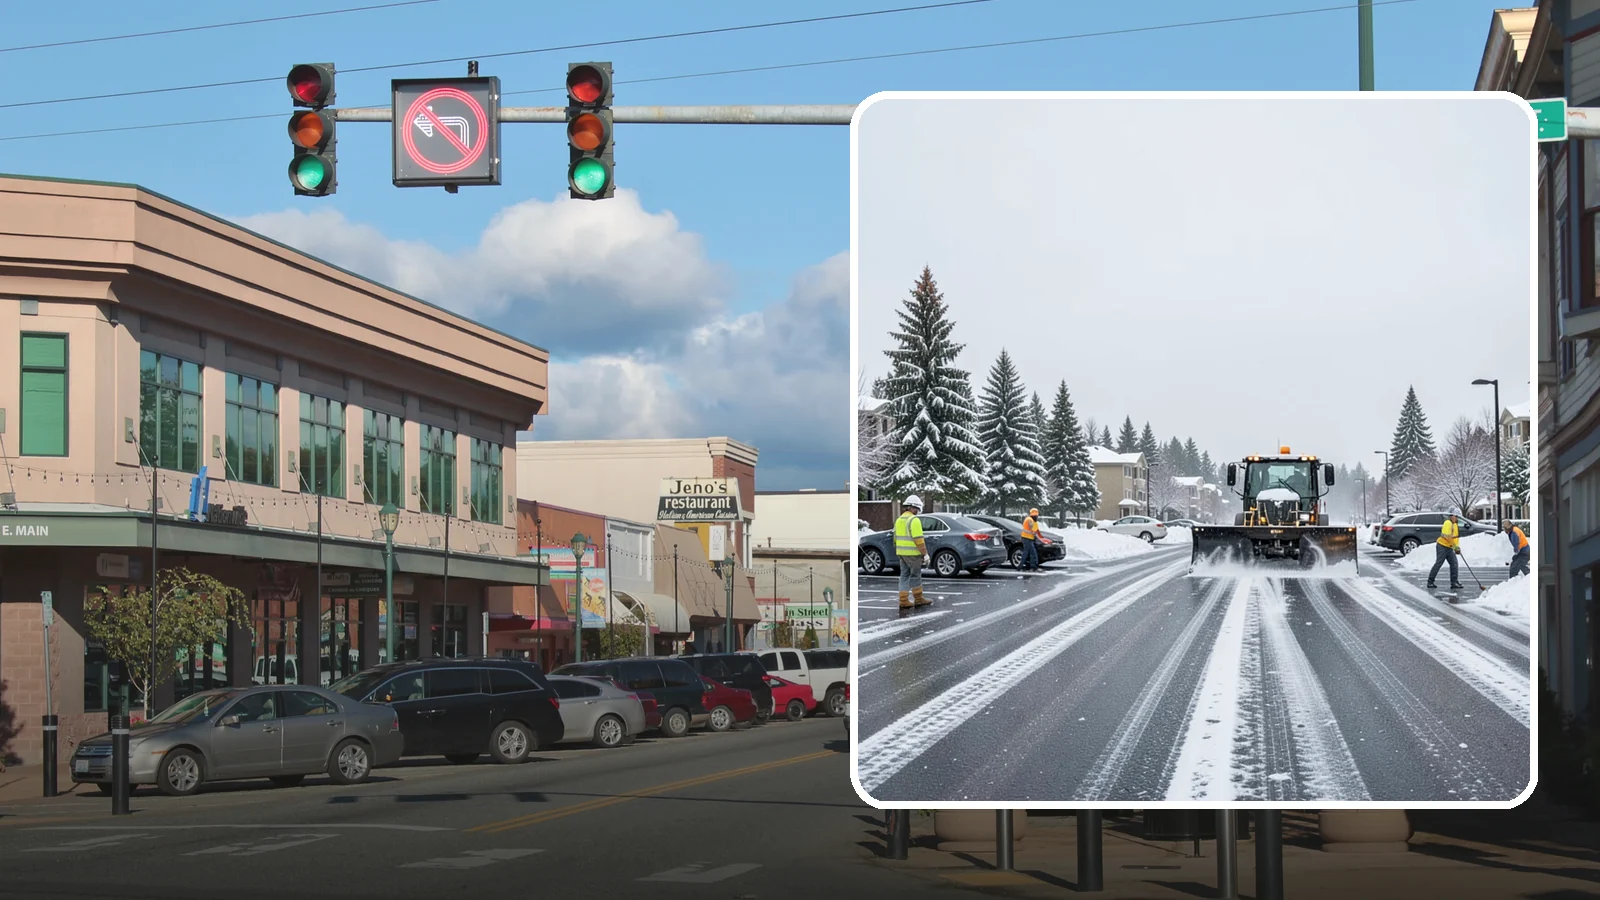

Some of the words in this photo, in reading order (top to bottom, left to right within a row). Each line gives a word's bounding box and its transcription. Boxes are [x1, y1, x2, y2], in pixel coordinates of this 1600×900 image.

[670, 480, 727, 494] Jeno's
[665, 496, 731, 509] restaurant
[658, 510, 681, 519] Italian
[686, 509, 714, 519] American
[715, 509, 737, 519] Cuisine
[2, 525, 13, 536] E.
[15, 525, 49, 536] MAIN
[797, 608, 828, 616] Street
